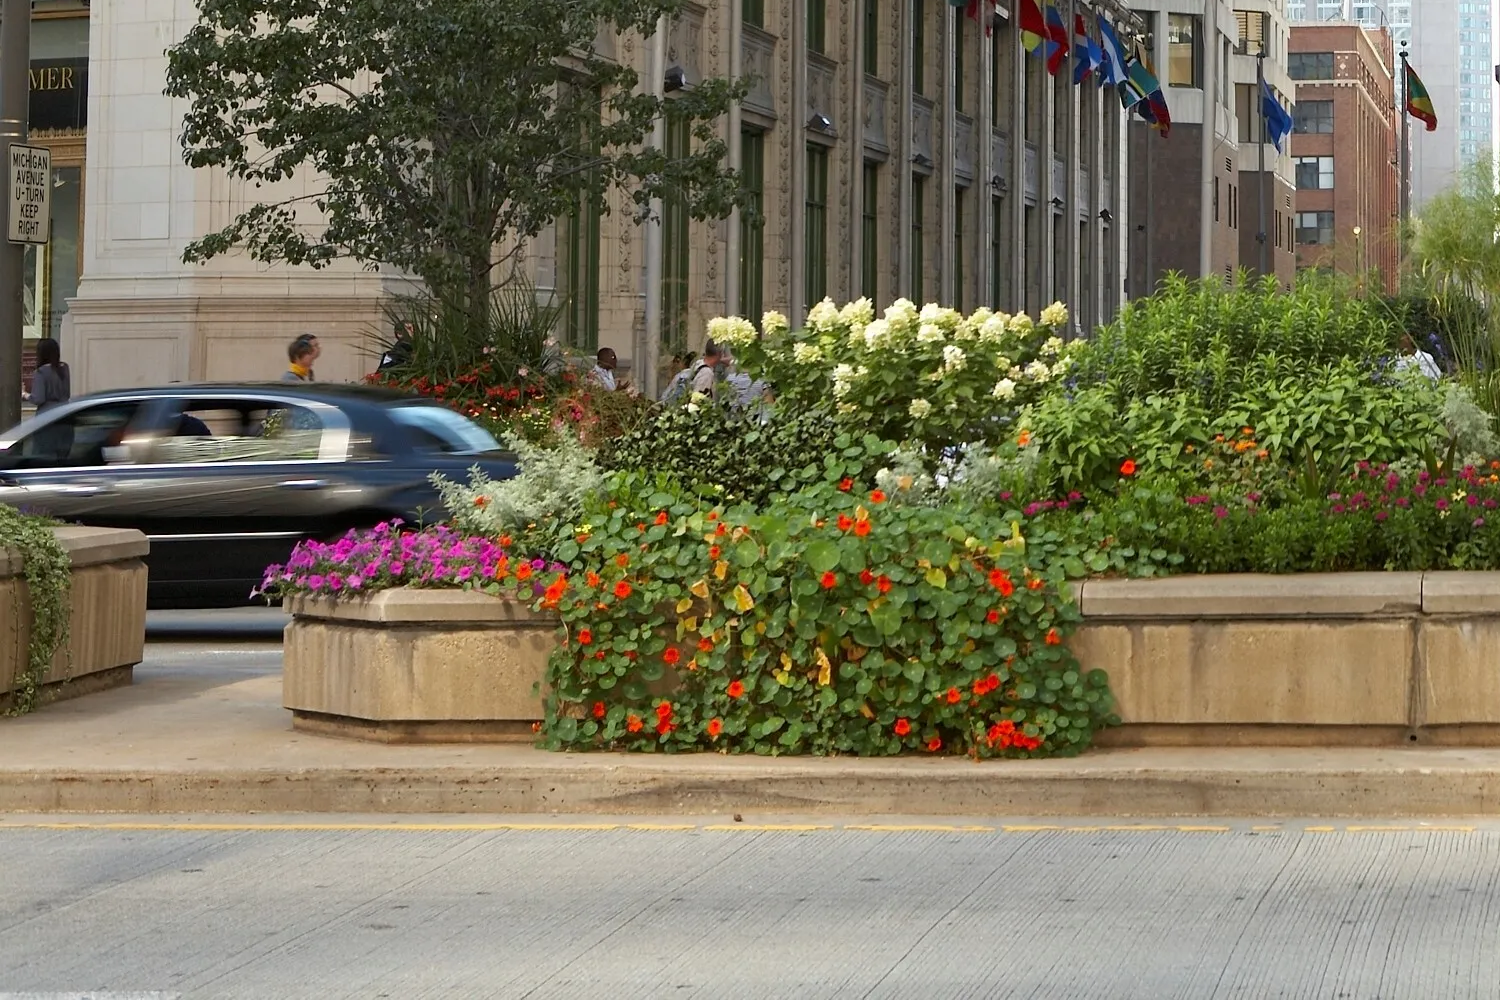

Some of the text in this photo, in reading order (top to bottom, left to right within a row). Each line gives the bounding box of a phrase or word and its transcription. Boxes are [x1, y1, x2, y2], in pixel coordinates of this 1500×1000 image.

[12, 152, 48, 170] MICHIGAN
[16, 170, 45, 187] AVENUE
[15, 186, 45, 203] U-TURN
[20, 203, 39, 219] KEEP
[18, 219, 39, 236] RIGHT
